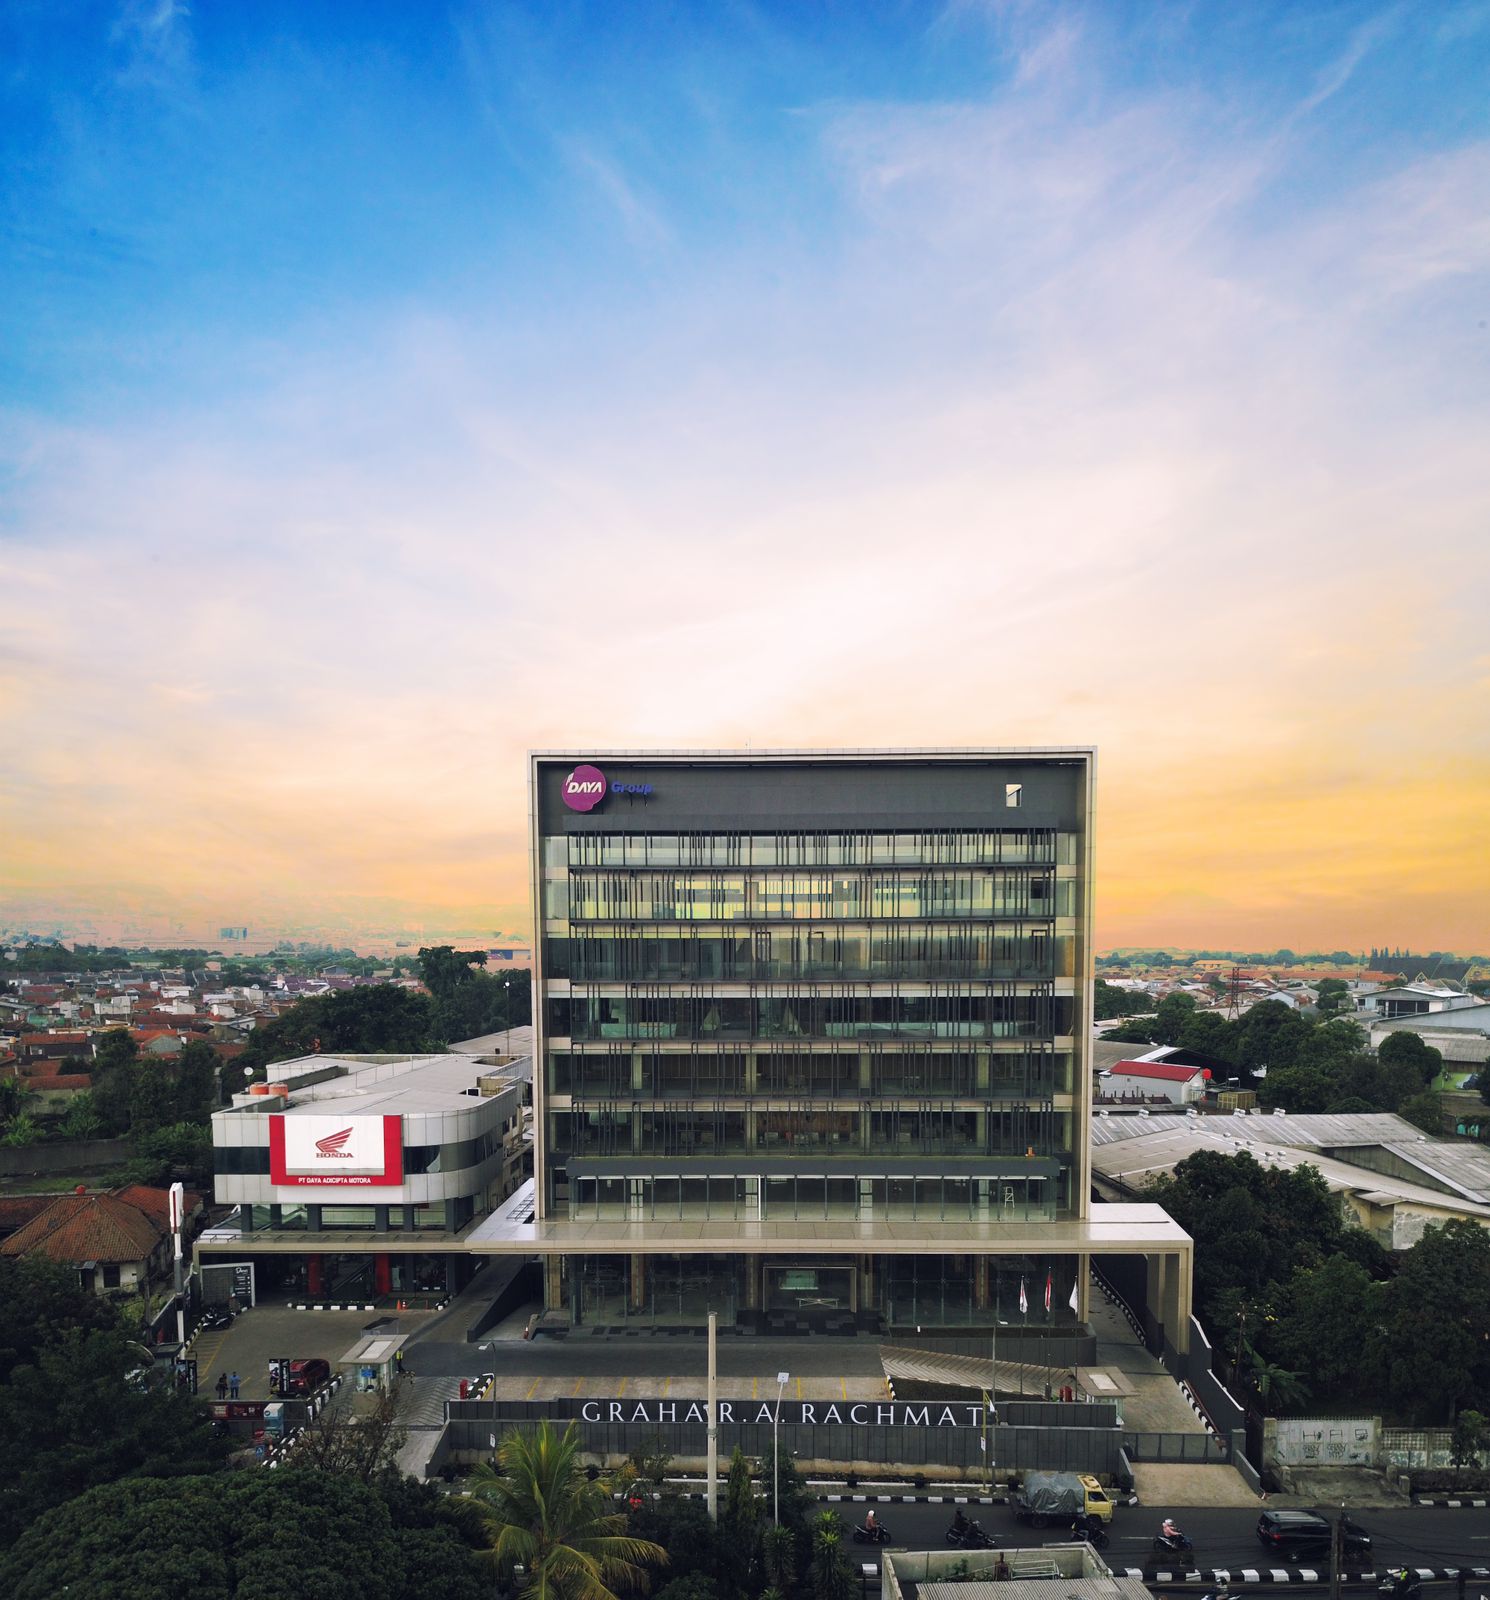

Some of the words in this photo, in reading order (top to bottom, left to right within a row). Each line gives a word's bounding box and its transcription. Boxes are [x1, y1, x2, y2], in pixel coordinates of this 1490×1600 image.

[567, 782, 602, 793] DAYA
[611, 781, 653, 794] Group
[581, 1401, 704, 1423] GRAHA
[801, 1403, 984, 1427] RACHMAT
